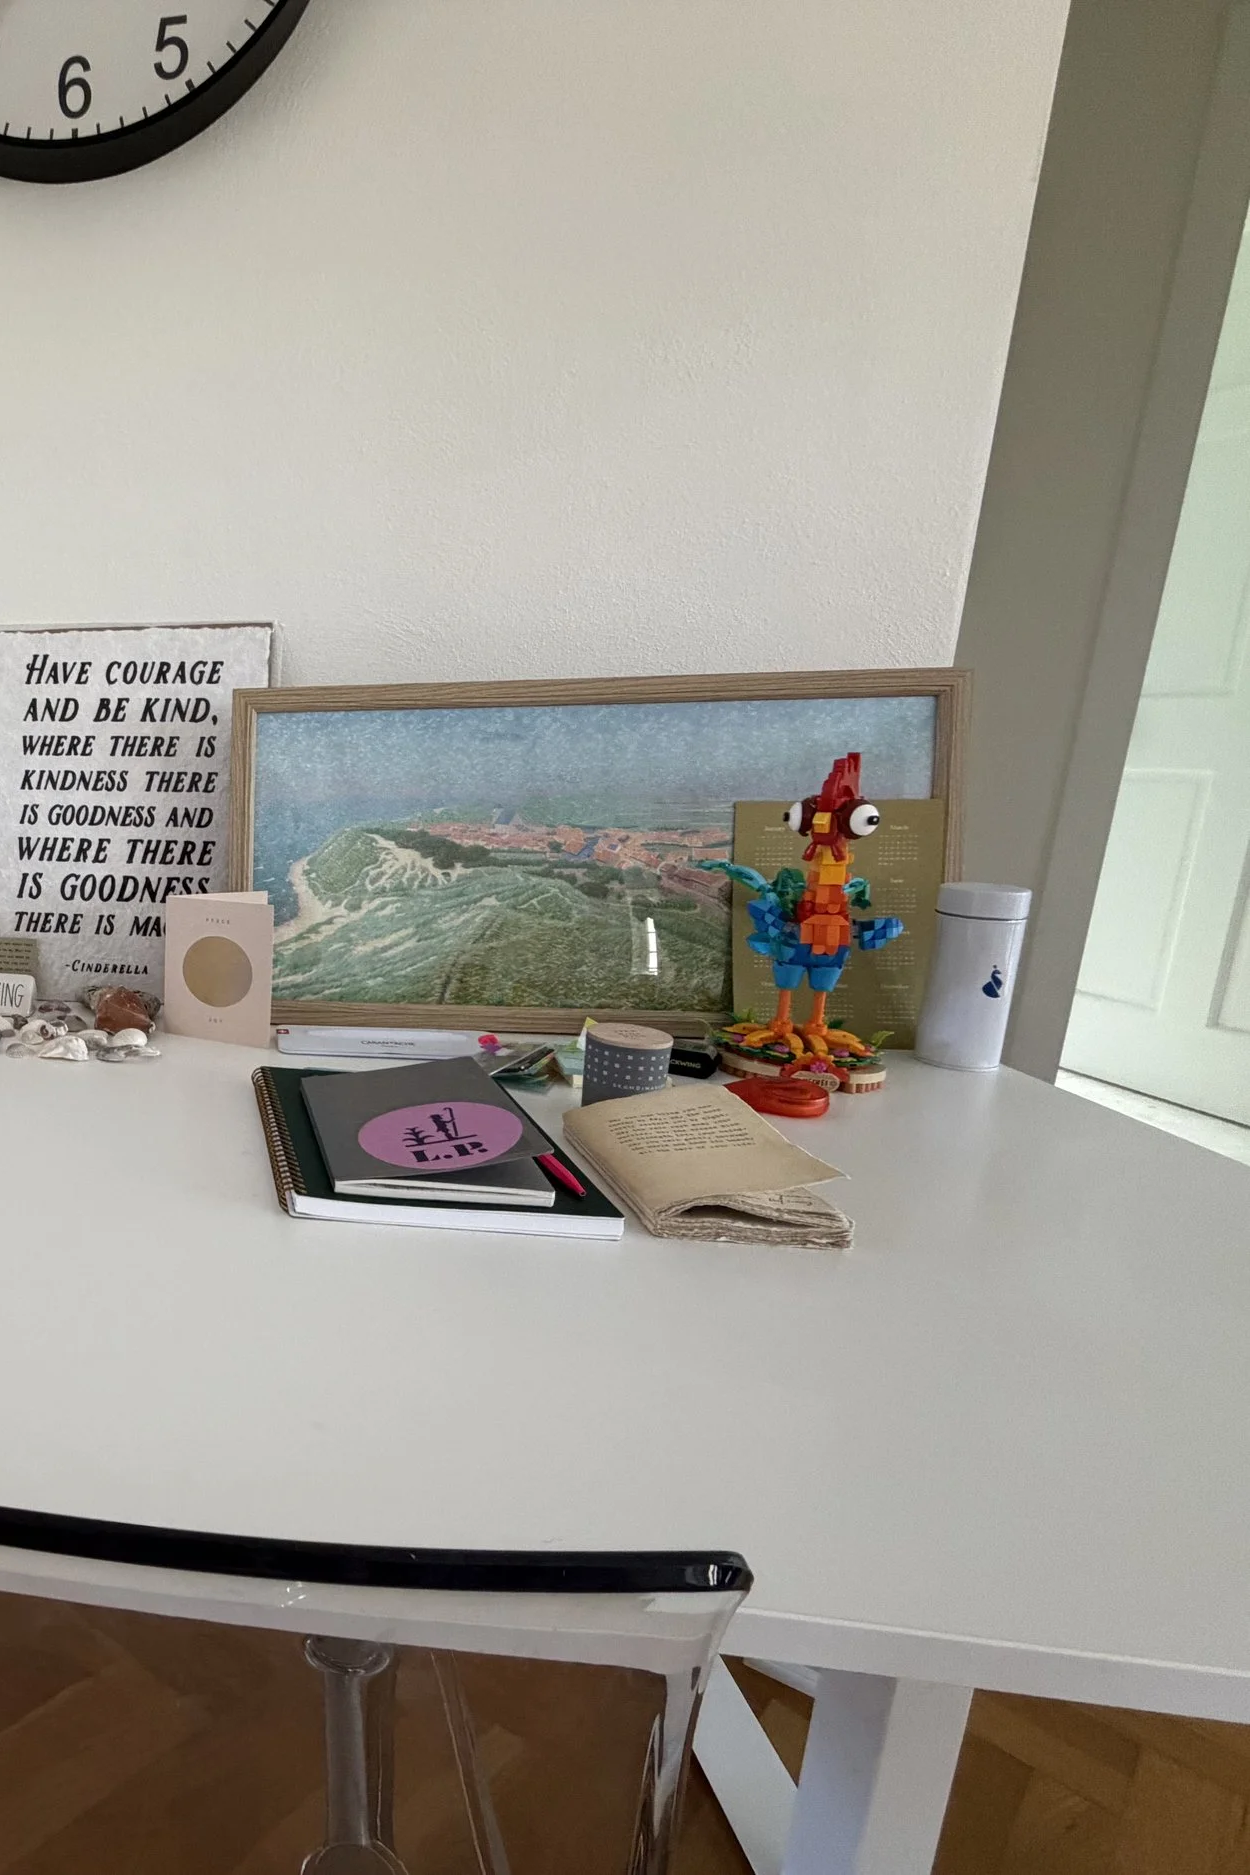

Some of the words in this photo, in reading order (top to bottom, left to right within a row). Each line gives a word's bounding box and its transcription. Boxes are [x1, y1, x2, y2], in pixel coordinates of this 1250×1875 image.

[153, 14, 191, 80] 5
[57, 55, 91, 119] 6
[25, 654, 92, 684] HAVE
[106, 660, 224, 685] COURAGE
[23, 698, 79, 722] AND
[93, 698, 129, 722] BE
[140, 698, 218, 726] KIND,
[23, 735, 95, 756] WHERE
[110, 736, 180, 757] THERE
[195, 736, 217, 758] IS
[20, 770, 128, 792] KINDNESS
[145, 771, 220, 796] THERE
[20, 804, 39, 825] IS
[48, 804, 156, 827] GOODNESS
[165, 807, 216, 831] AND
[18, 837, 111, 863] WHERE
[126, 839, 218, 869] THERE
[17, 872, 43, 899] IS
[60, 873, 215, 901] GOODNESS
[15, 912, 83, 934] THERE
[95, 914, 115, 935] IS
[129, 916, 166, 937] MA
